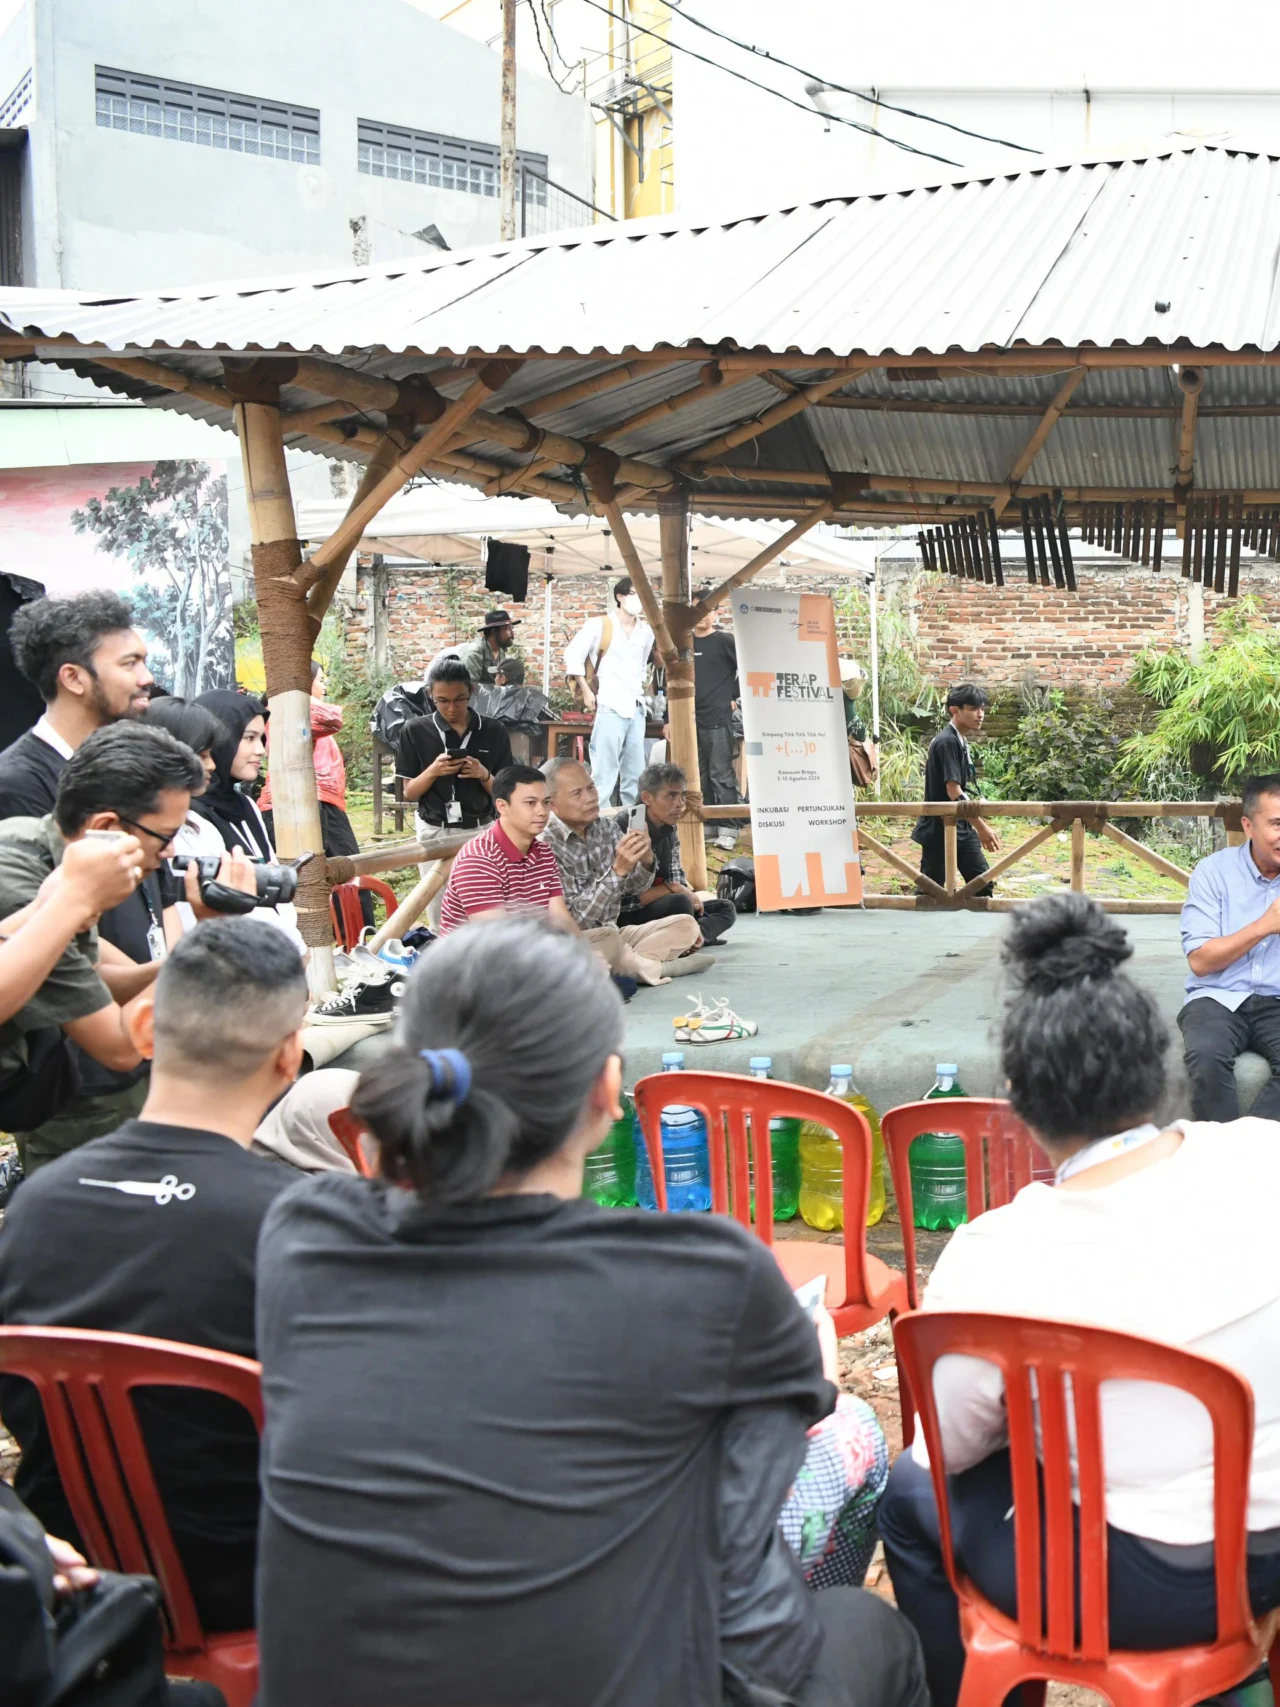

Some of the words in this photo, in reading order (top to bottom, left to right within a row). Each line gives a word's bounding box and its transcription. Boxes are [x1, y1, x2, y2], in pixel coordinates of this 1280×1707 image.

[776, 673, 817, 686] TERAP
[776, 685, 834, 699] FESTIVAL
[757, 806, 790, 814] INKUBASI
[797, 804, 846, 813] PERTUNJUKAN
[758, 820, 785, 828] DISKUSI
[808, 818, 847, 827] WORKSHOP
